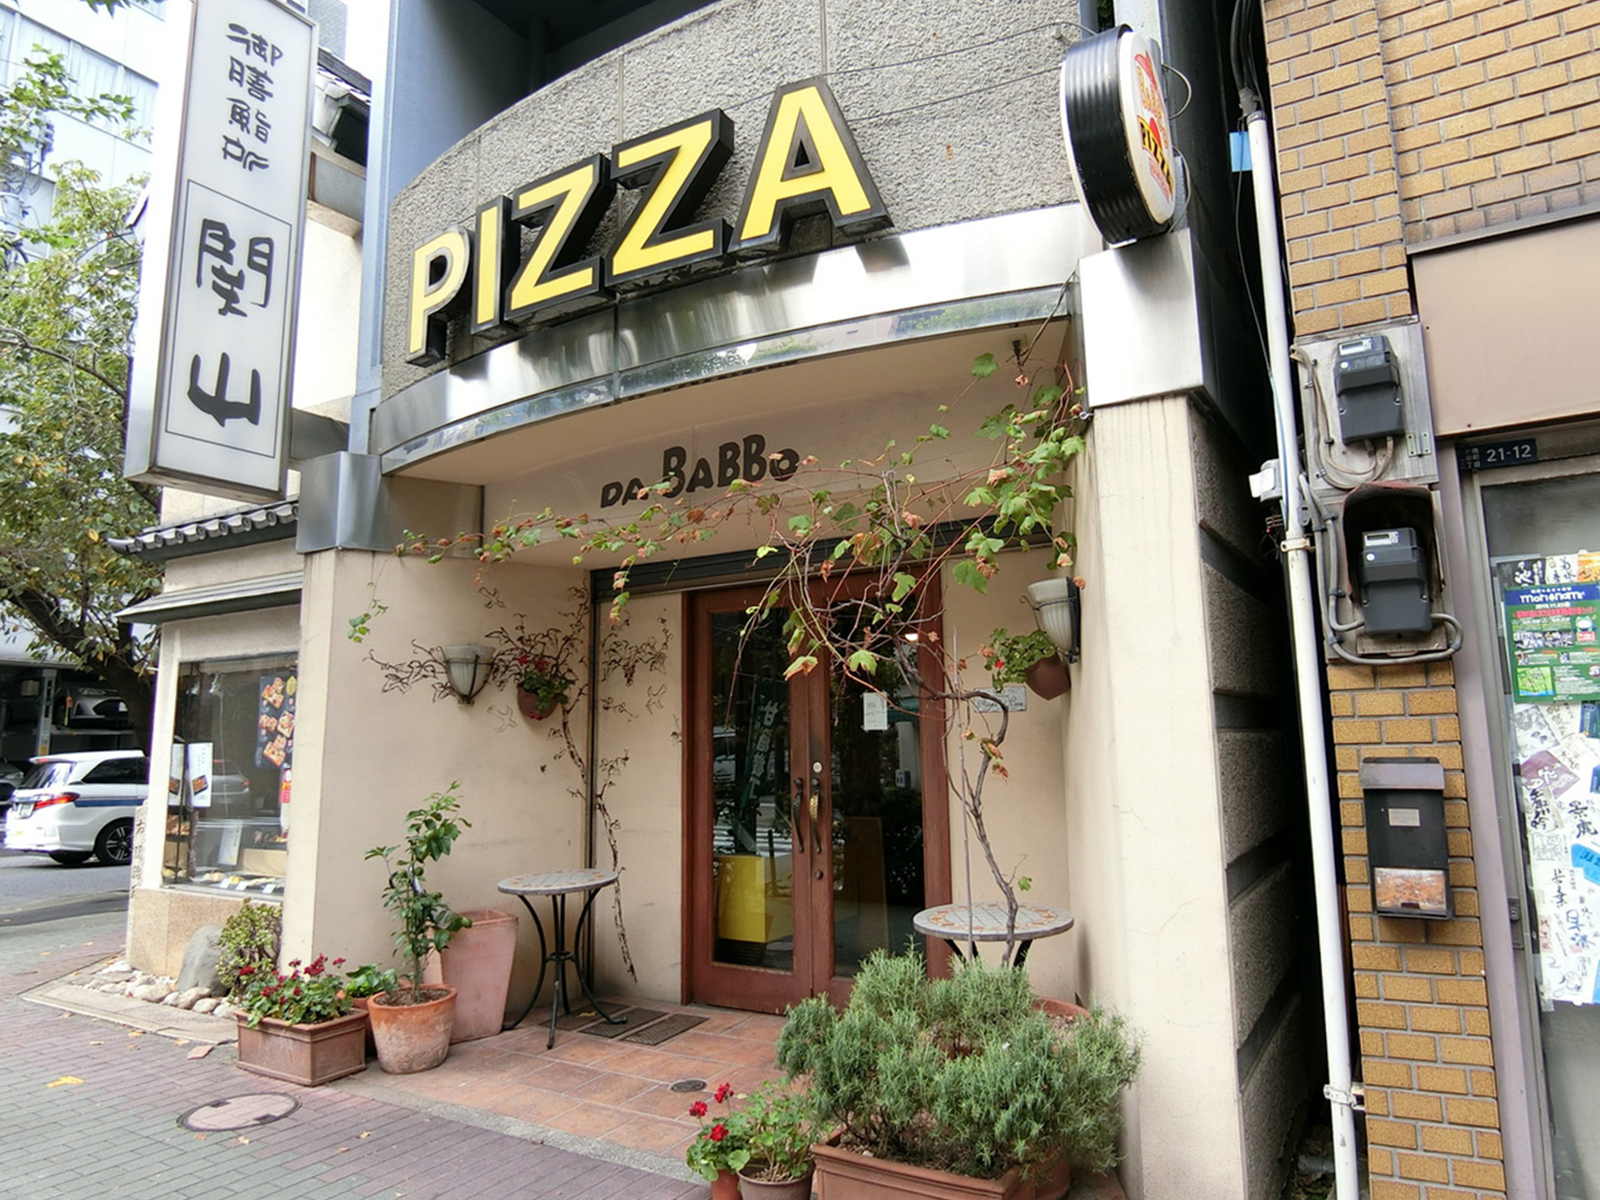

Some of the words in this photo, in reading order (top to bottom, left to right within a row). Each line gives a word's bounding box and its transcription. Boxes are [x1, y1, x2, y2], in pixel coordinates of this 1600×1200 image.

[405, 77, 893, 366] PIZZA
[600, 477, 650, 508] DA
[662, 433, 800, 498] BABBO
[1486, 444, 1532, 463] 21-12
